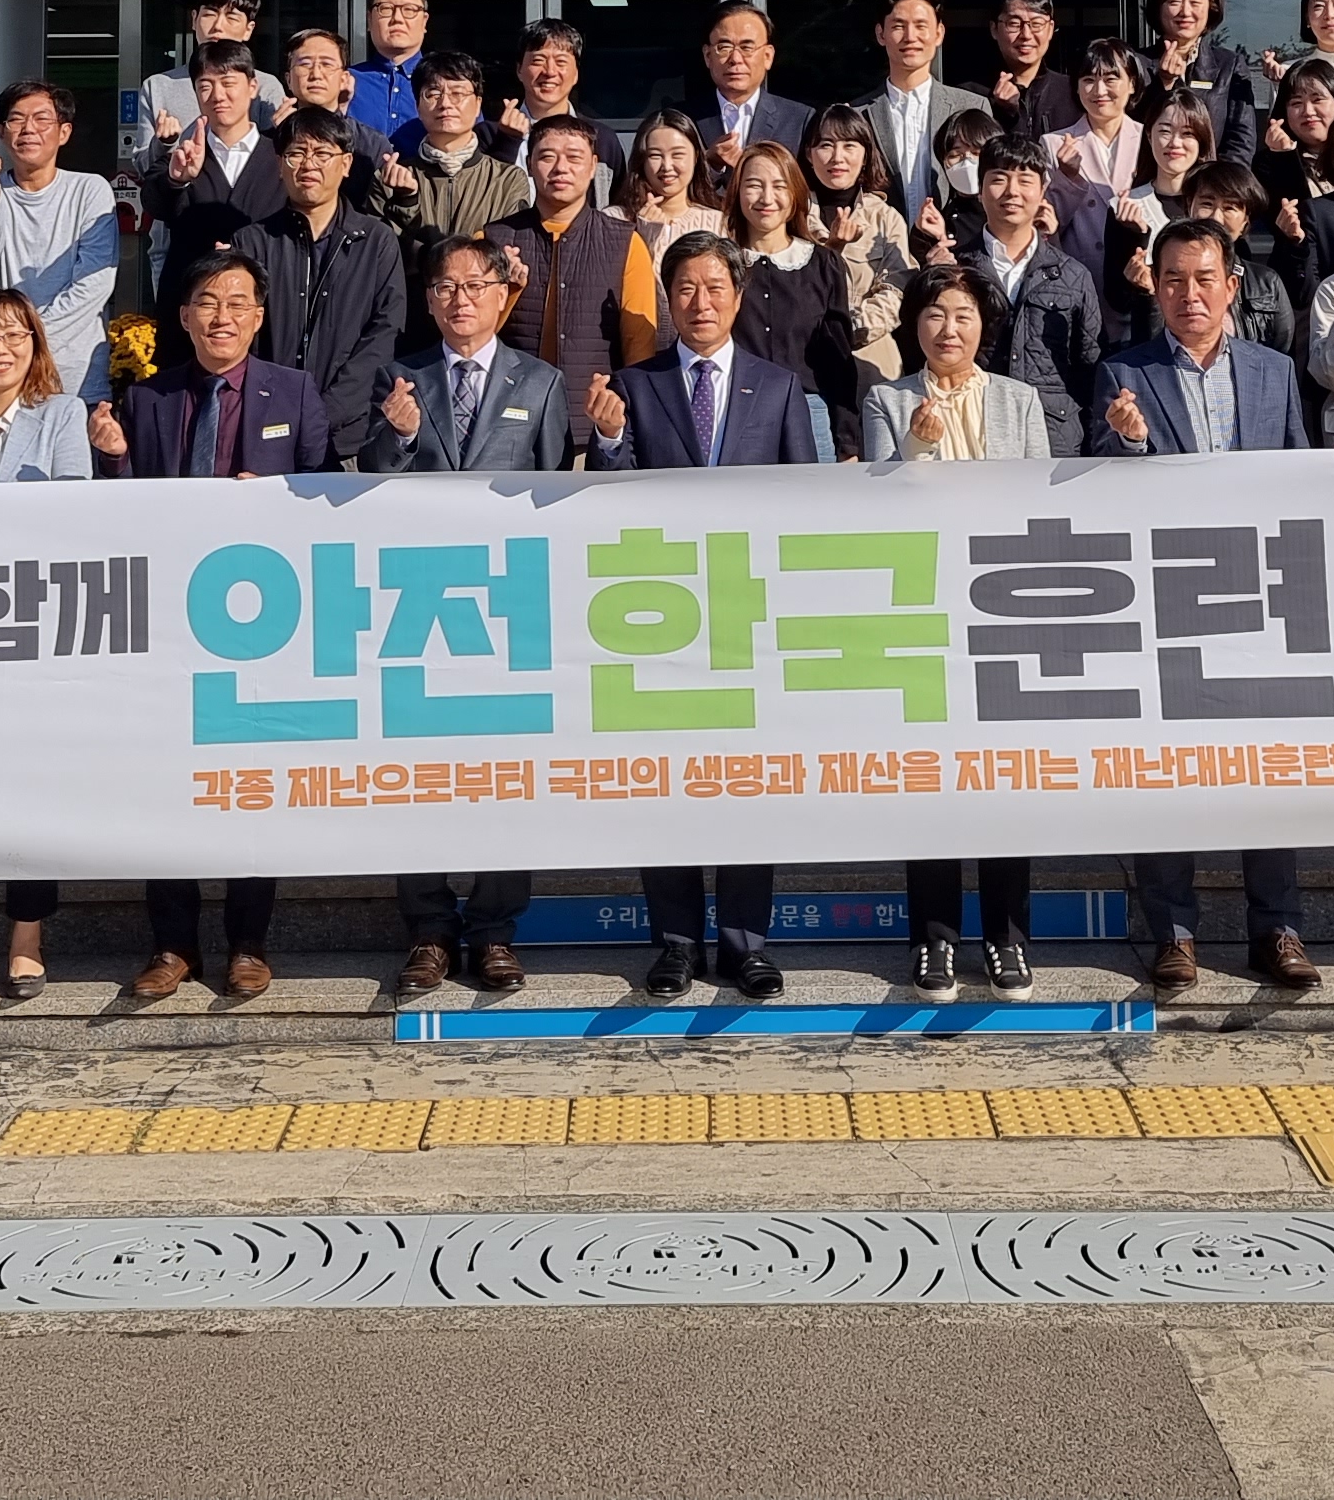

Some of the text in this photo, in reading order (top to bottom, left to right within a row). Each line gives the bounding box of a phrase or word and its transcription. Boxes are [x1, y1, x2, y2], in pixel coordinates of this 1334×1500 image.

[192, 768, 275, 812] 각종
[287, 759, 535, 808] 재난으로부터
[547, 755, 670, 801] 국민의
[682, 752, 808, 799] 생명과
[817, 750, 942, 795] 재산을
[954, 748, 1079, 792] 지키는
